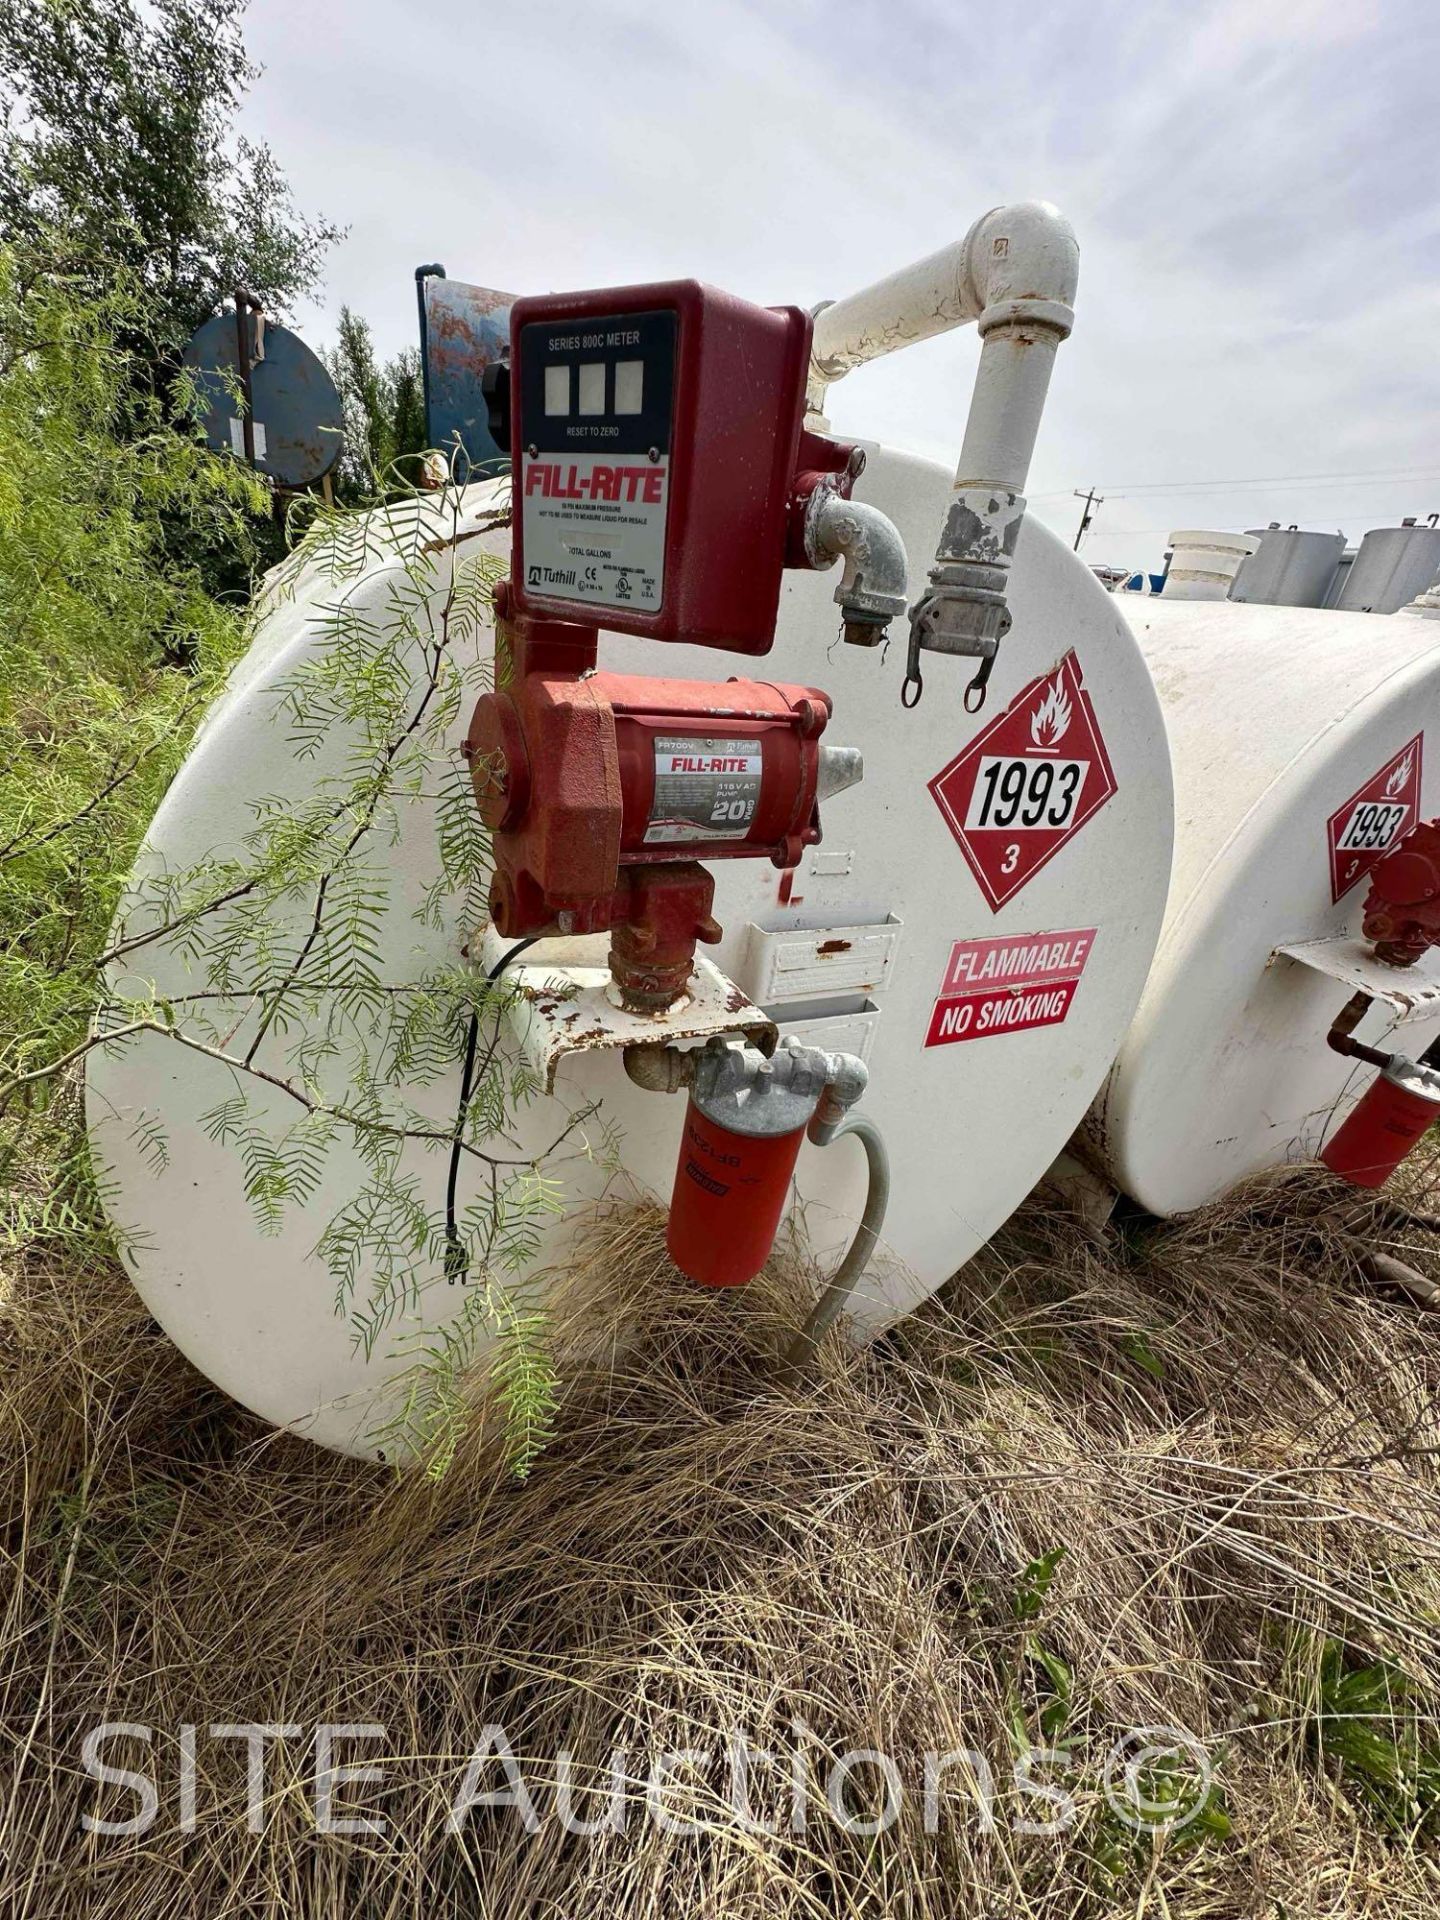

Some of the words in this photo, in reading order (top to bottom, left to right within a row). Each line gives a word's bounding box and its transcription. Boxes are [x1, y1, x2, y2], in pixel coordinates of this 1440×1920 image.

[549, 336, 580, 351] SERIES
[583, 334, 604, 348] 800C
[606, 330, 640, 346] METER
[567, 427, 588, 436] RESET
[590, 427, 599, 436] TO
[600, 427, 620, 436] ZERO
[526, 464, 666, 504] FILL-RITE
[580, 513, 601, 521] MEASURE
[628, 517, 647, 525] RESALE
[568, 547, 584, 556] TOTAL
[586, 549, 612, 559] GALLONS
[543, 568, 576, 585] Tuthill
[585, 567, 596, 581] CE
[642, 591, 655, 599] U.S.A.
[671, 758, 748, 772] FILL-RITE
[978, 761, 1080, 827] 1993
[710, 800, 746, 820] 20
[1344, 805, 1404, 848] 1993
[1001, 844, 1020, 874] 3
[1345, 859, 1360, 879] 3
[952, 940, 1088, 984] FLAMMABLE
[939, 1005, 974, 1036] NO
[976, 990, 1067, 1030] SMOKING
